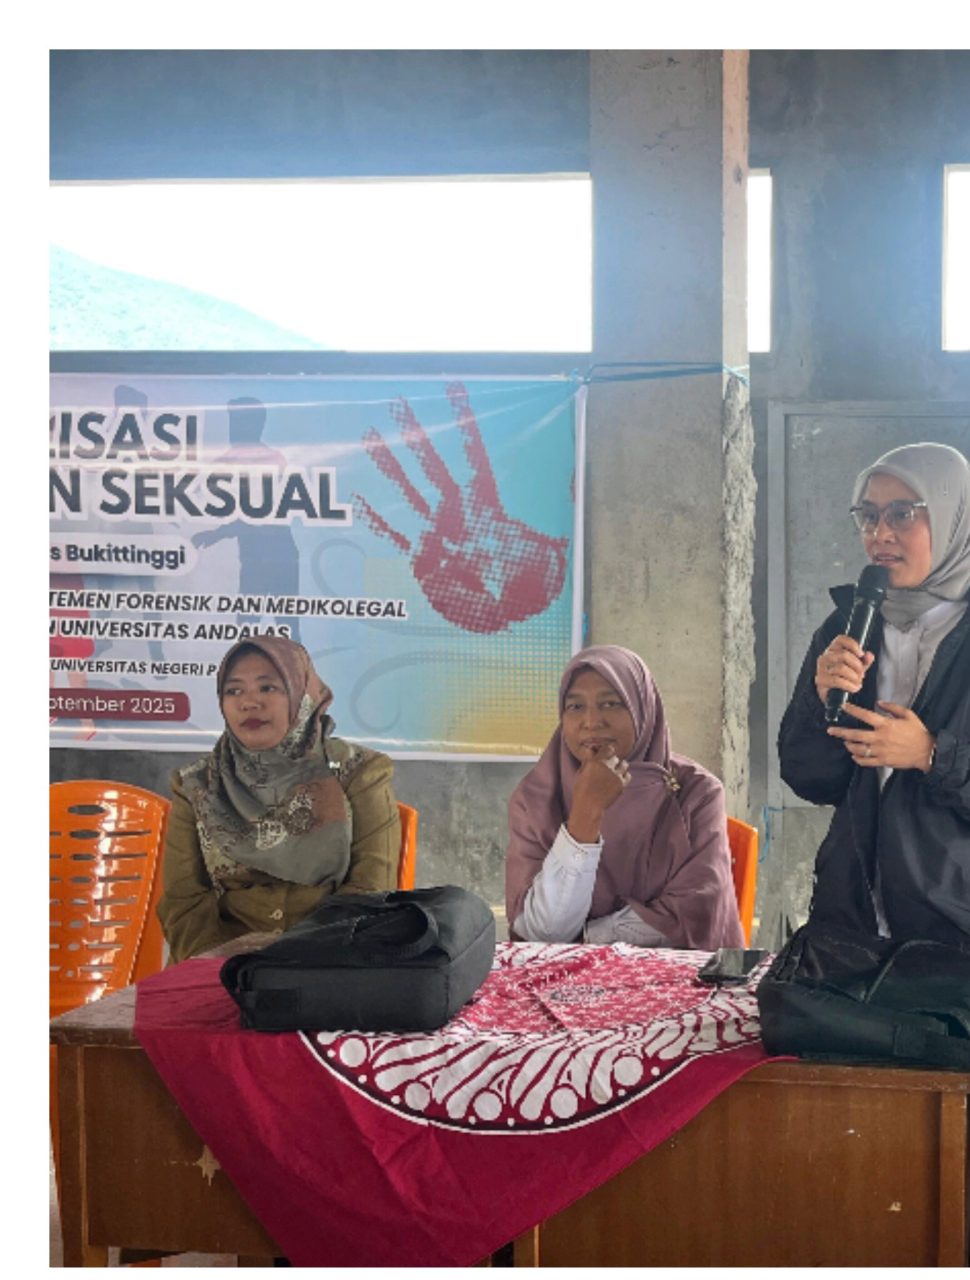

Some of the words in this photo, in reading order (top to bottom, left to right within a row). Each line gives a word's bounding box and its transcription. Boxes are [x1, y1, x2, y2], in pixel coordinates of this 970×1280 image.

[100, 468, 347, 521] SEKSUAL
[66, 542, 186, 570] Bukittinggi
[116, 593, 213, 612] FORENSIK
[217, 596, 262, 613] DAN
[266, 598, 407, 617] MEDIKOLEGAL
[61, 620, 189, 639] UNIVERSITAS
[50, 659, 147, 674] UNIVERSITAS
[151, 663, 203, 676] NEGERI
[131, 698, 176, 714] 2025
